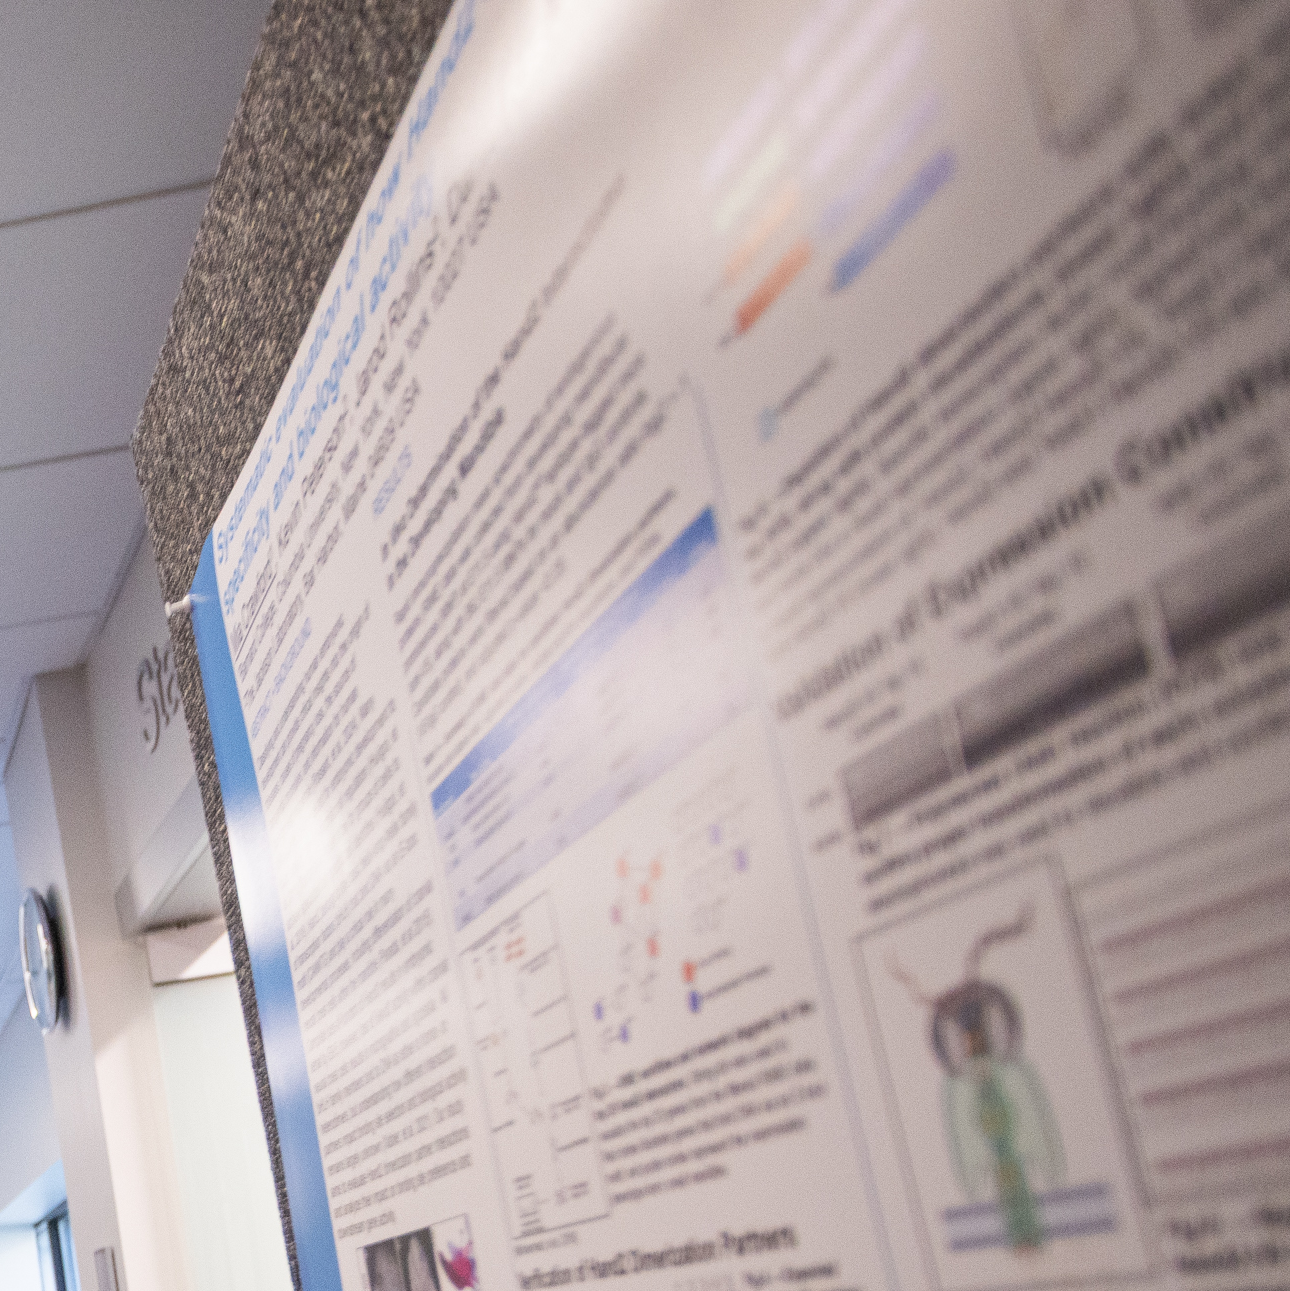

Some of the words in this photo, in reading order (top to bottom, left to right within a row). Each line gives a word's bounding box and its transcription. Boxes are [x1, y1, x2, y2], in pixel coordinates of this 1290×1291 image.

[218, 438, 272, 563] Systematic
[274, 287, 342, 442] evaluation
[226, 507, 270, 609] specificity
[272, 450, 296, 511] and
[296, 312, 365, 458] biological
